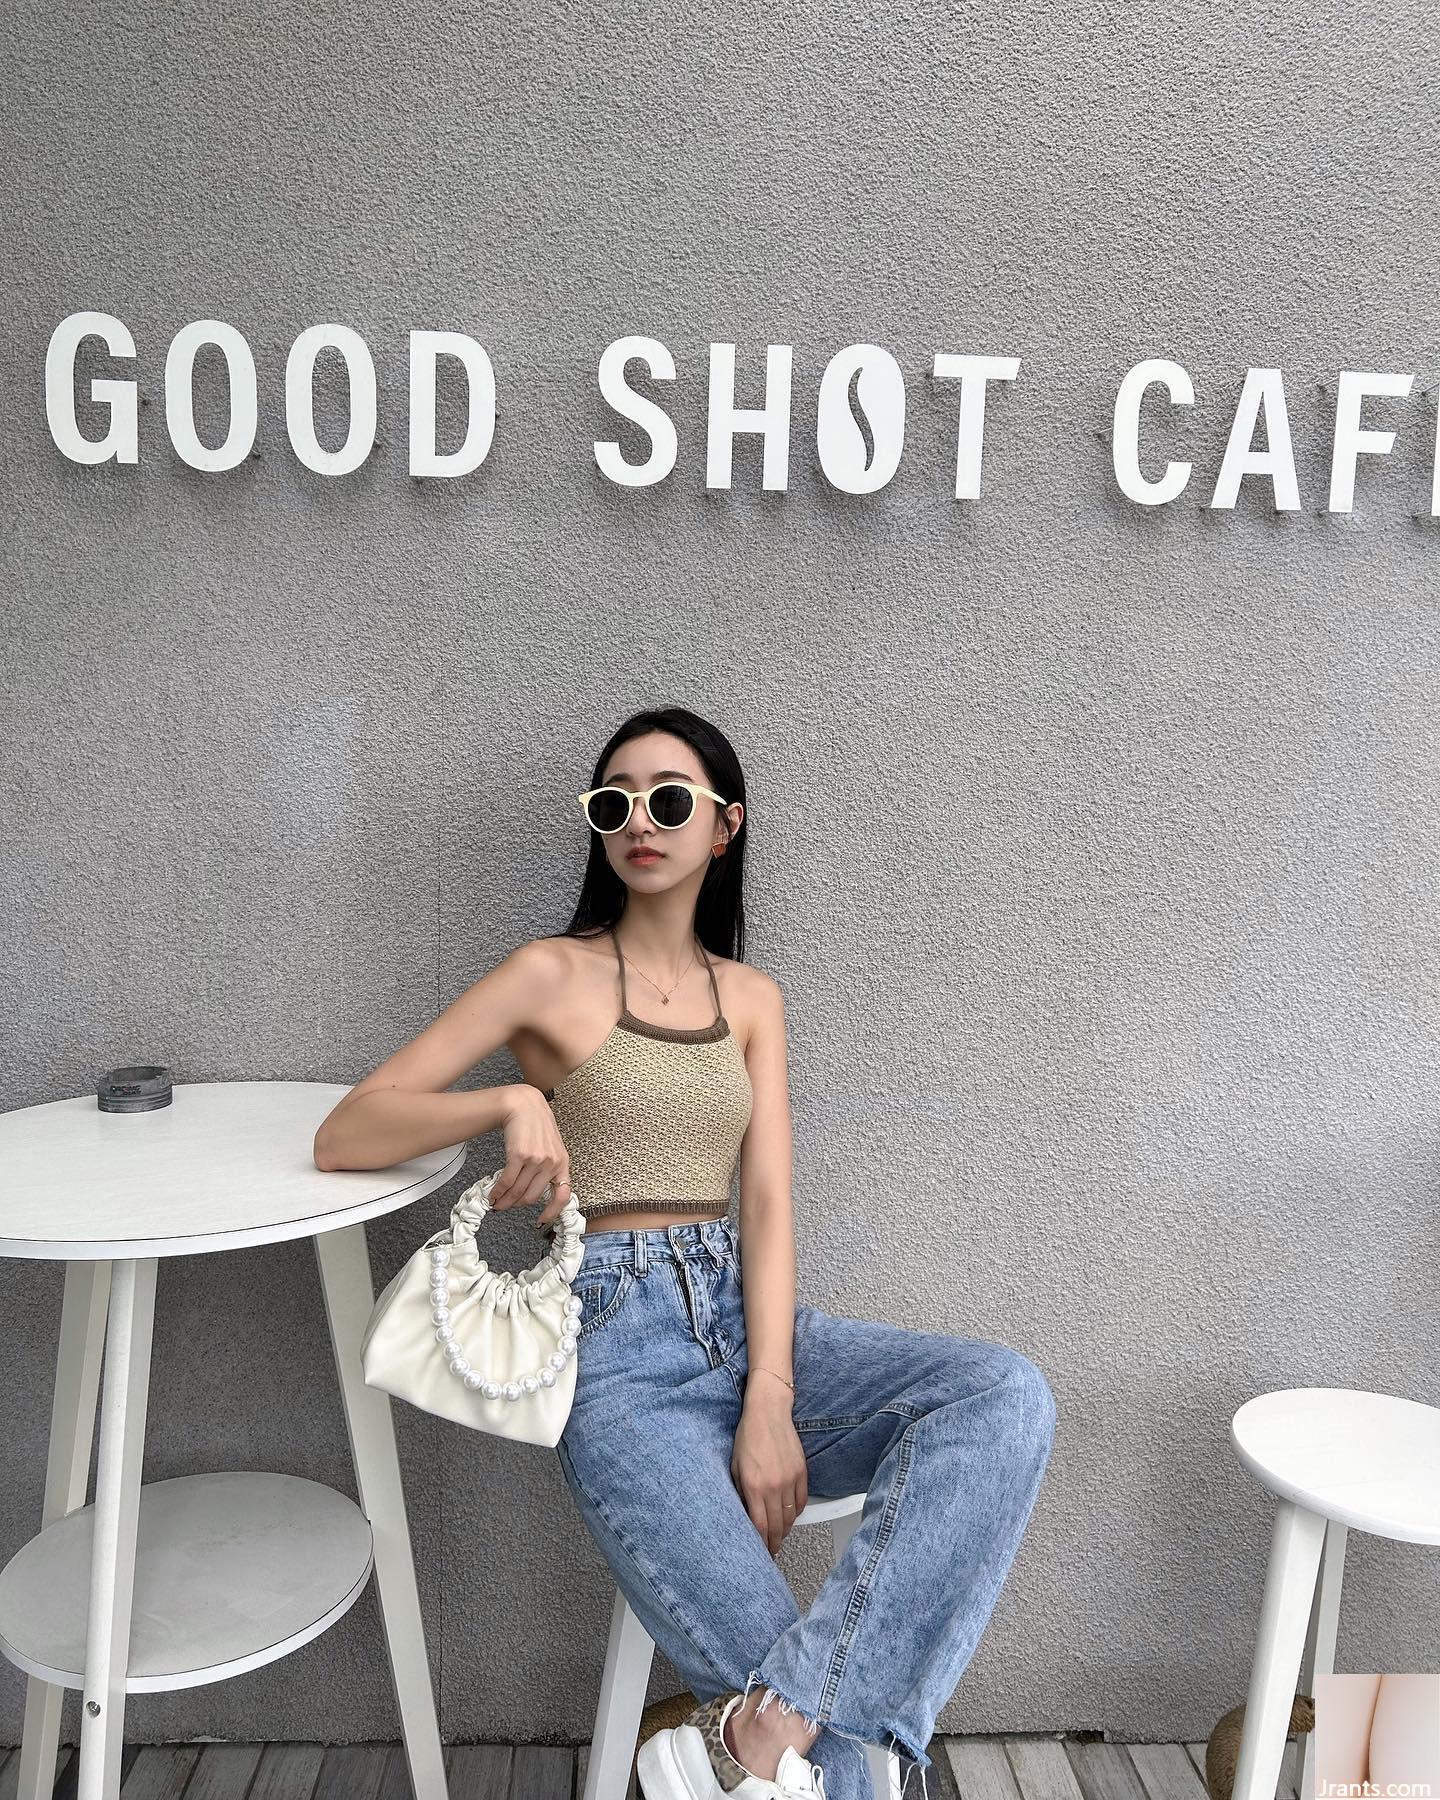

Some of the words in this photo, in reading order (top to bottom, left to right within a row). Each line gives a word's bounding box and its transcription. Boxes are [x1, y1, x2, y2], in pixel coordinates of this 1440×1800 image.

[45, 311, 497, 477] GOOD
[594, 336, 1022, 499] SHOT
[1113, 359, 1440, 516] CAF
